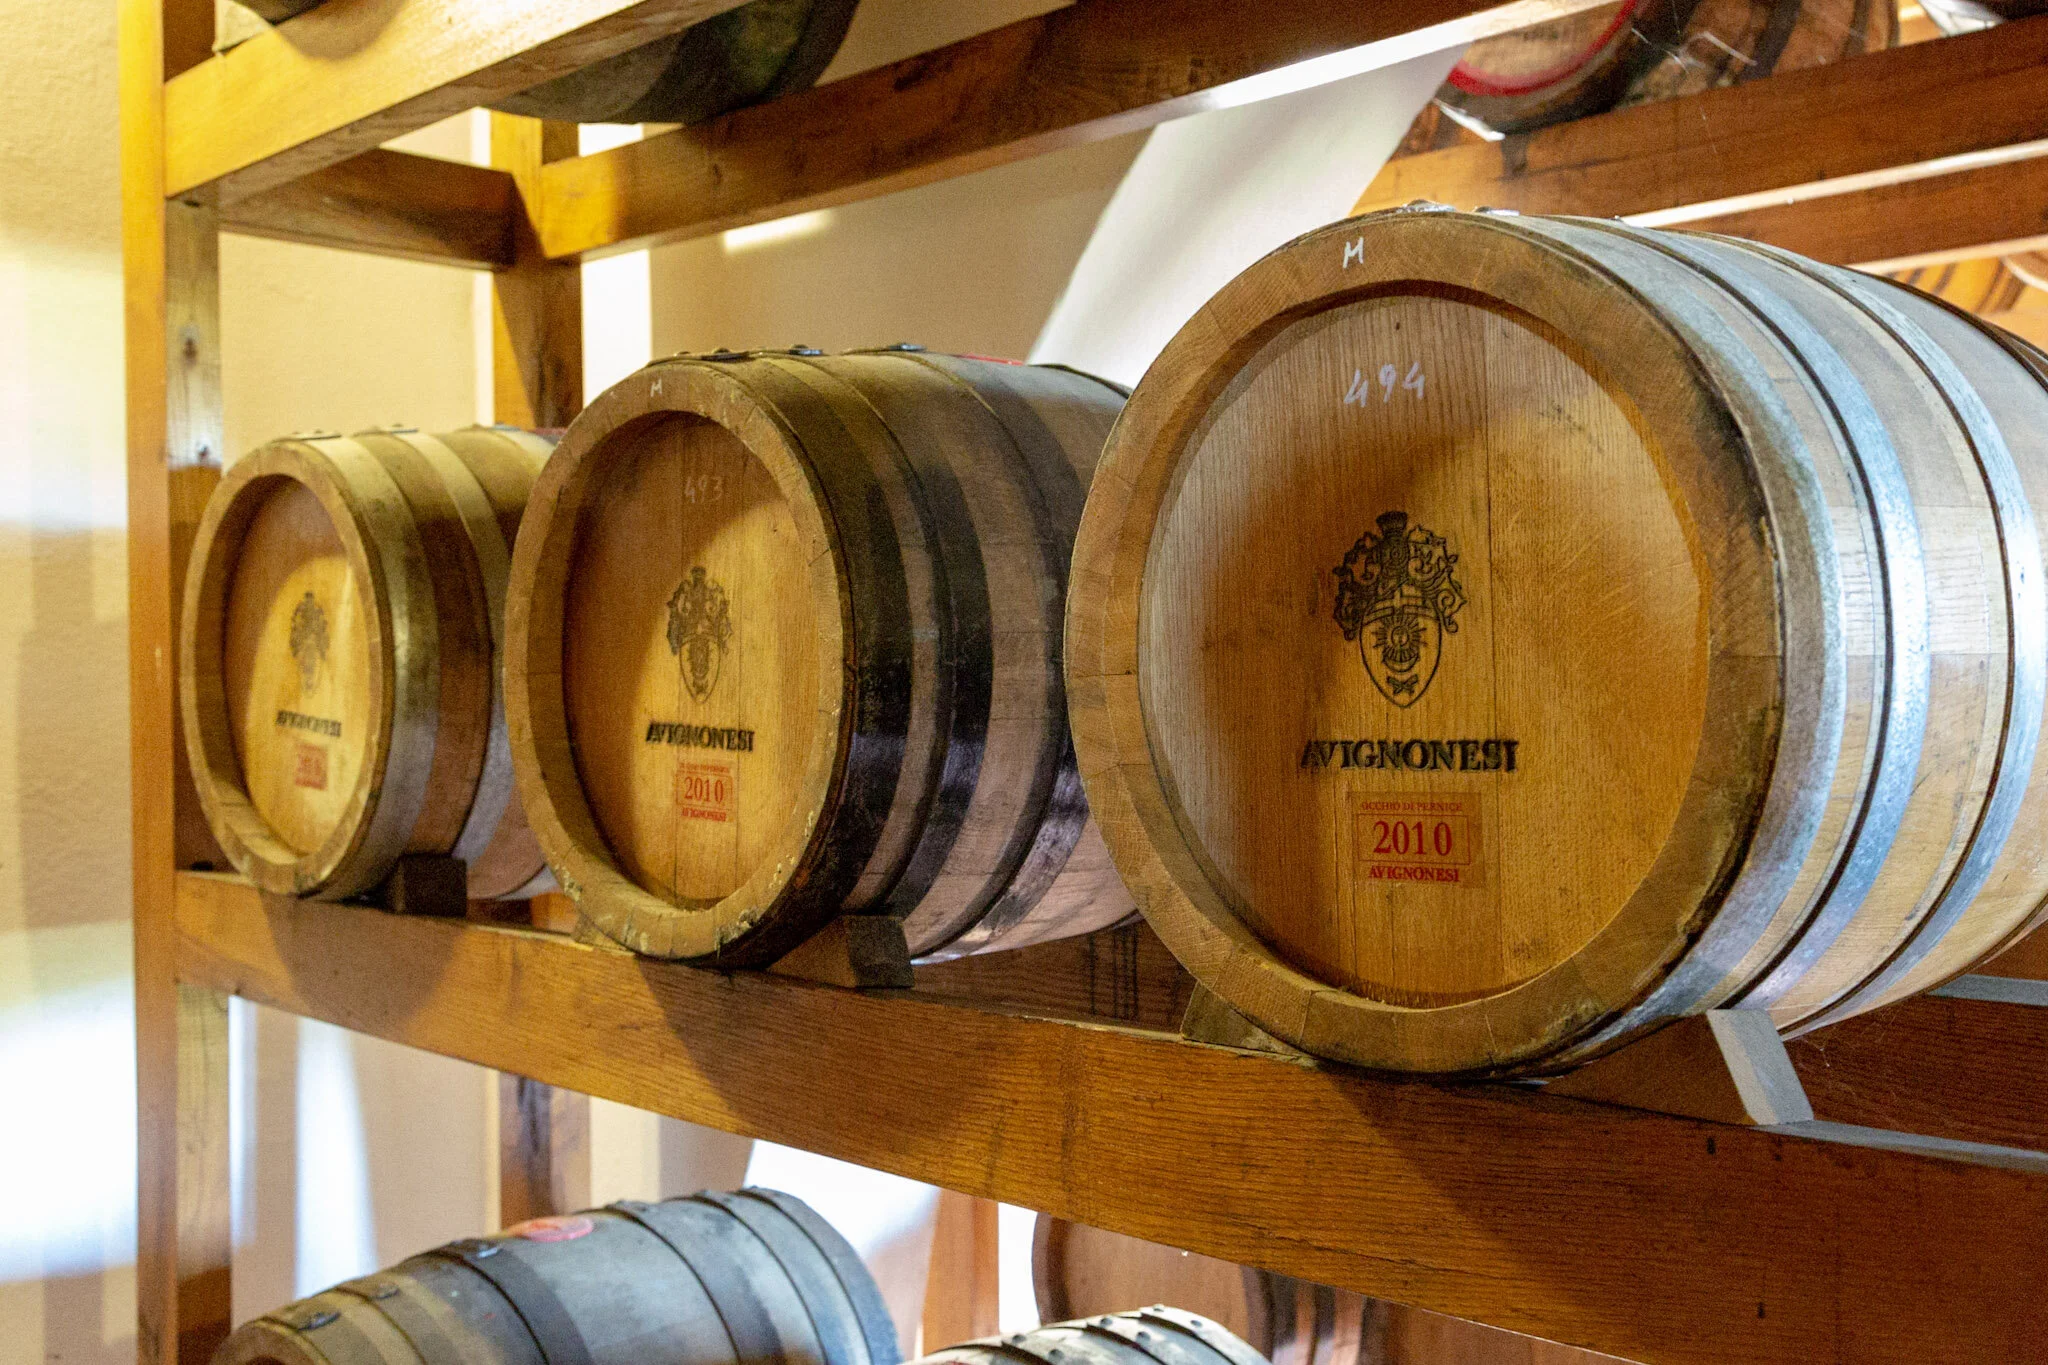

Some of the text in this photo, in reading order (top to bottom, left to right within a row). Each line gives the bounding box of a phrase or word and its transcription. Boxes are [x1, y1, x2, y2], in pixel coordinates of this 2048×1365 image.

[1343, 236, 1364, 268] M
[1344, 361, 1425, 408] 494
[684, 474, 722, 503] 493
[646, 721, 754, 752] AVIGNONESI
[1301, 739, 1518, 771] AVIGNONESI
[684, 776, 724, 803] 2010
[1362, 801, 1462, 812] OCCHIO DI PERNICE
[1373, 820, 1453, 856] 2010
[1369, 865, 1460, 882] AVIGNONESI
